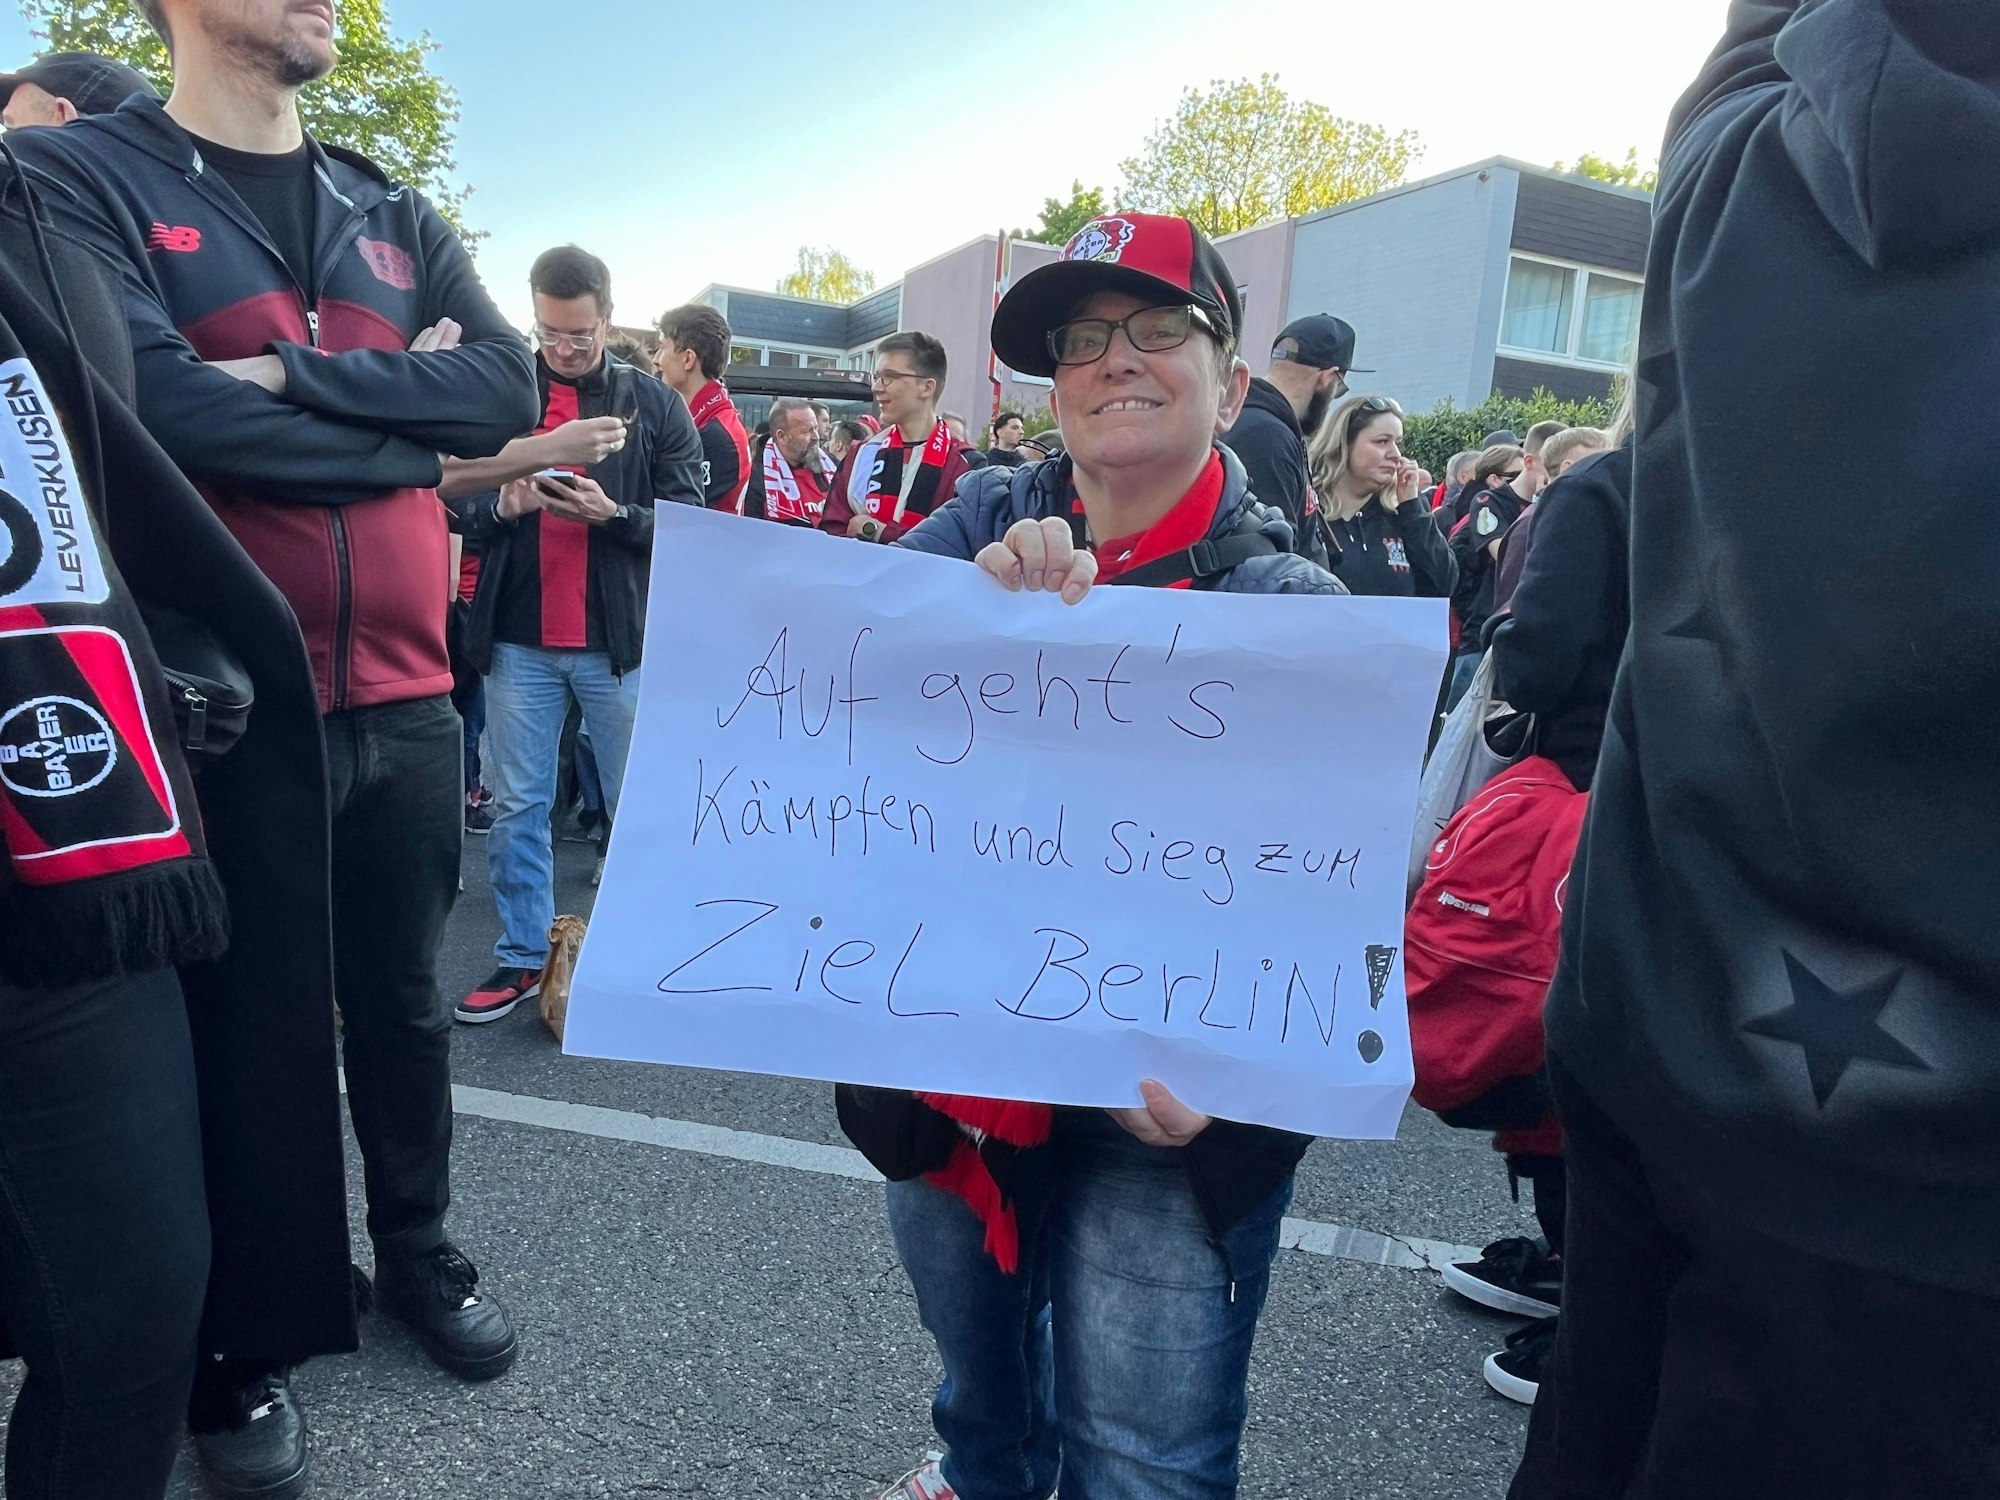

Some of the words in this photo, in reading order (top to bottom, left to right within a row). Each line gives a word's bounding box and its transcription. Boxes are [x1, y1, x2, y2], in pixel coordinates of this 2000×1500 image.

[0, 373, 84, 593] LEVERKUSEN
[0, 732, 109, 763] BAYER
[36, 705, 72, 790] BAYER
[717, 627, 879, 765] Auf
[916, 623, 1234, 764] geht's
[693, 759, 935, 857] Kämpfen
[974, 804, 1074, 868] und
